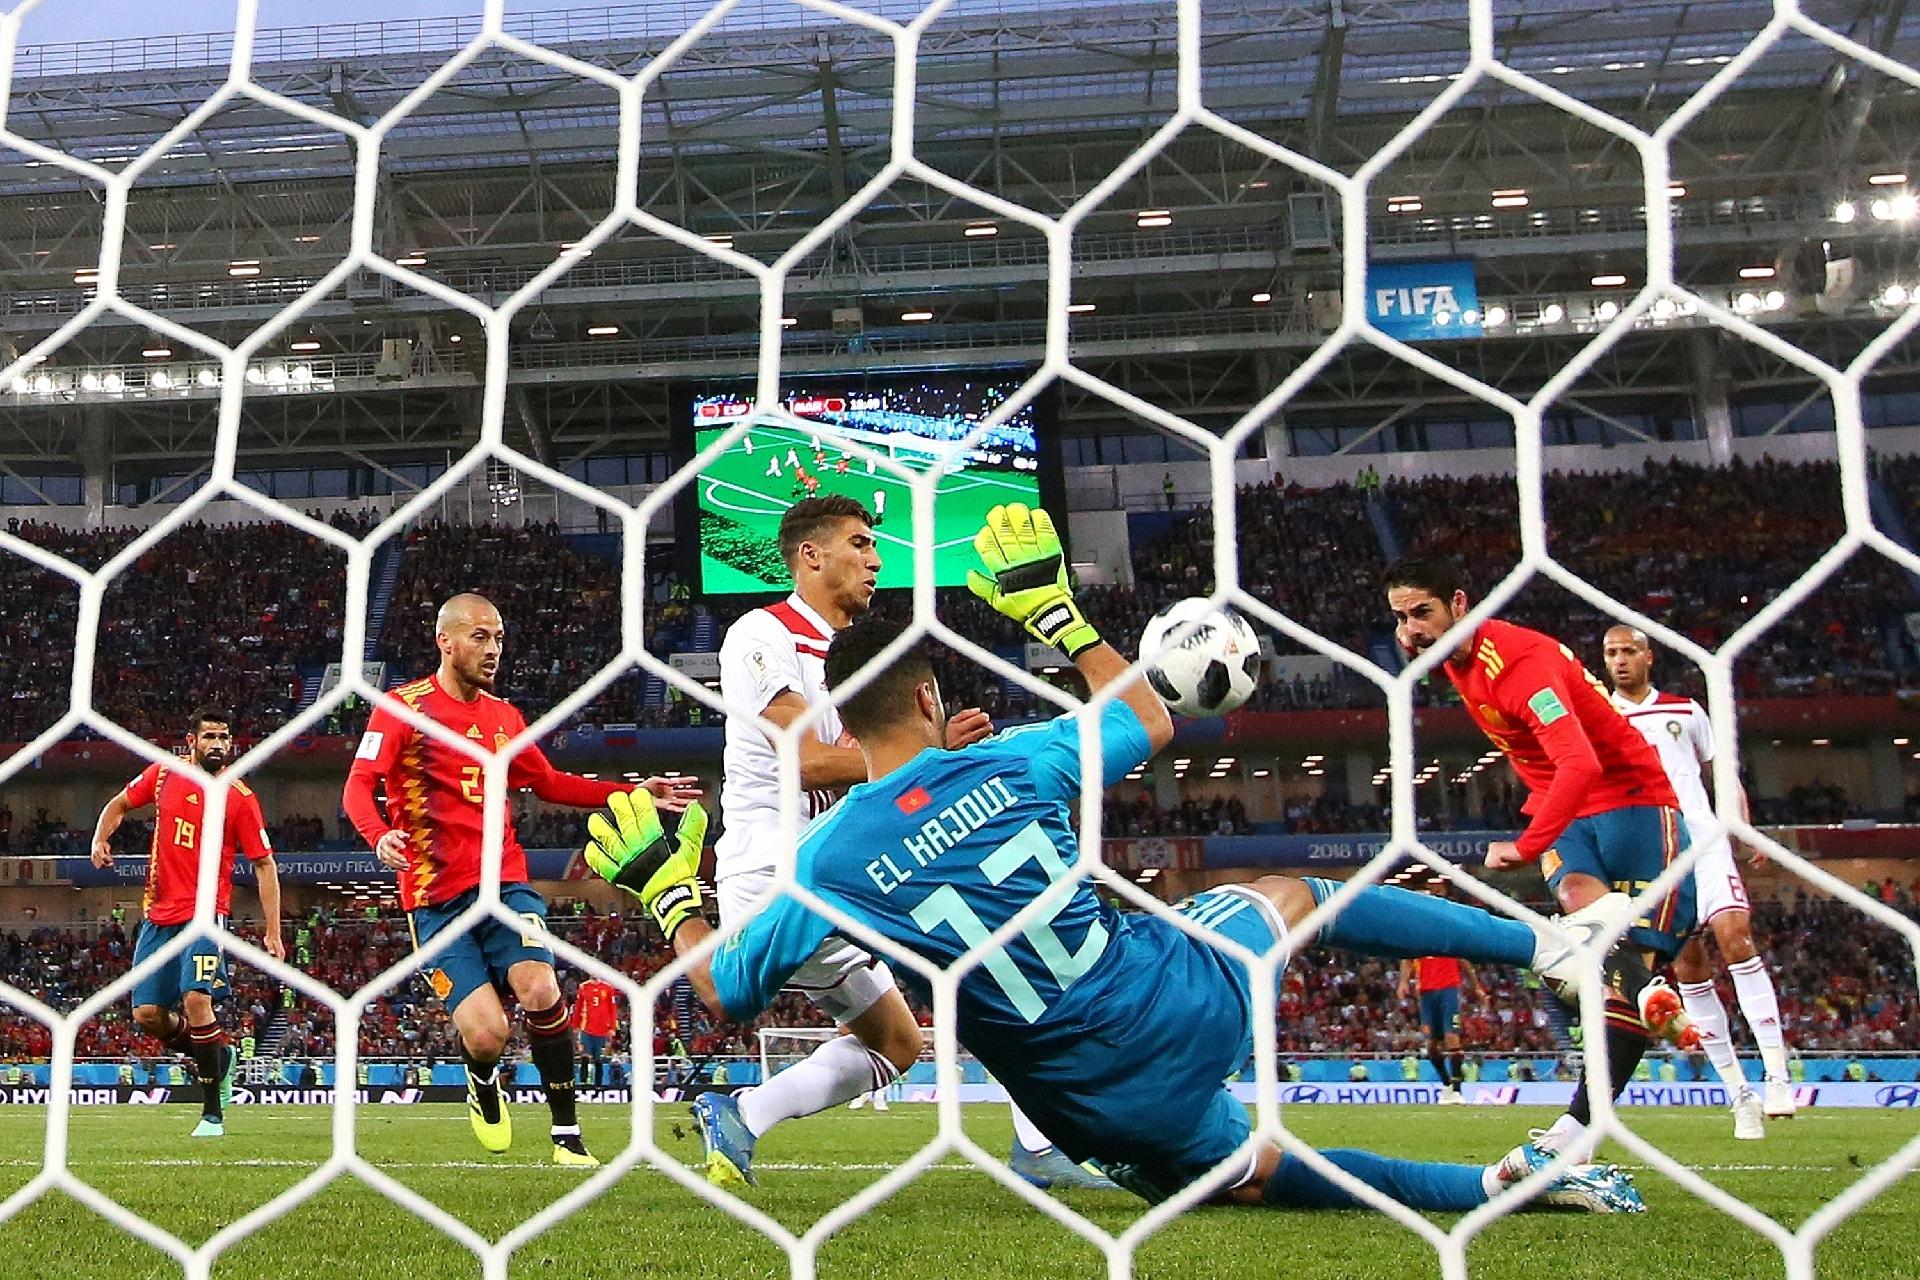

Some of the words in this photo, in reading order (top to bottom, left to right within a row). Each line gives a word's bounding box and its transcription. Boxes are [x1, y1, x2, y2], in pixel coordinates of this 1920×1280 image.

[1375, 286, 1461, 317] FIFA
[459, 766, 485, 803] 2
[173, 816, 196, 850] 19
[864, 853, 914, 896] EL
[903, 775, 1020, 868] KAJOUI
[345, 860, 376, 873] FIFA
[908, 819, 1110, 1025] 12
[193, 955, 218, 982] 19
[1337, 1088, 1442, 1104] HYUND
[1628, 1087, 1727, 1105] HYUND
